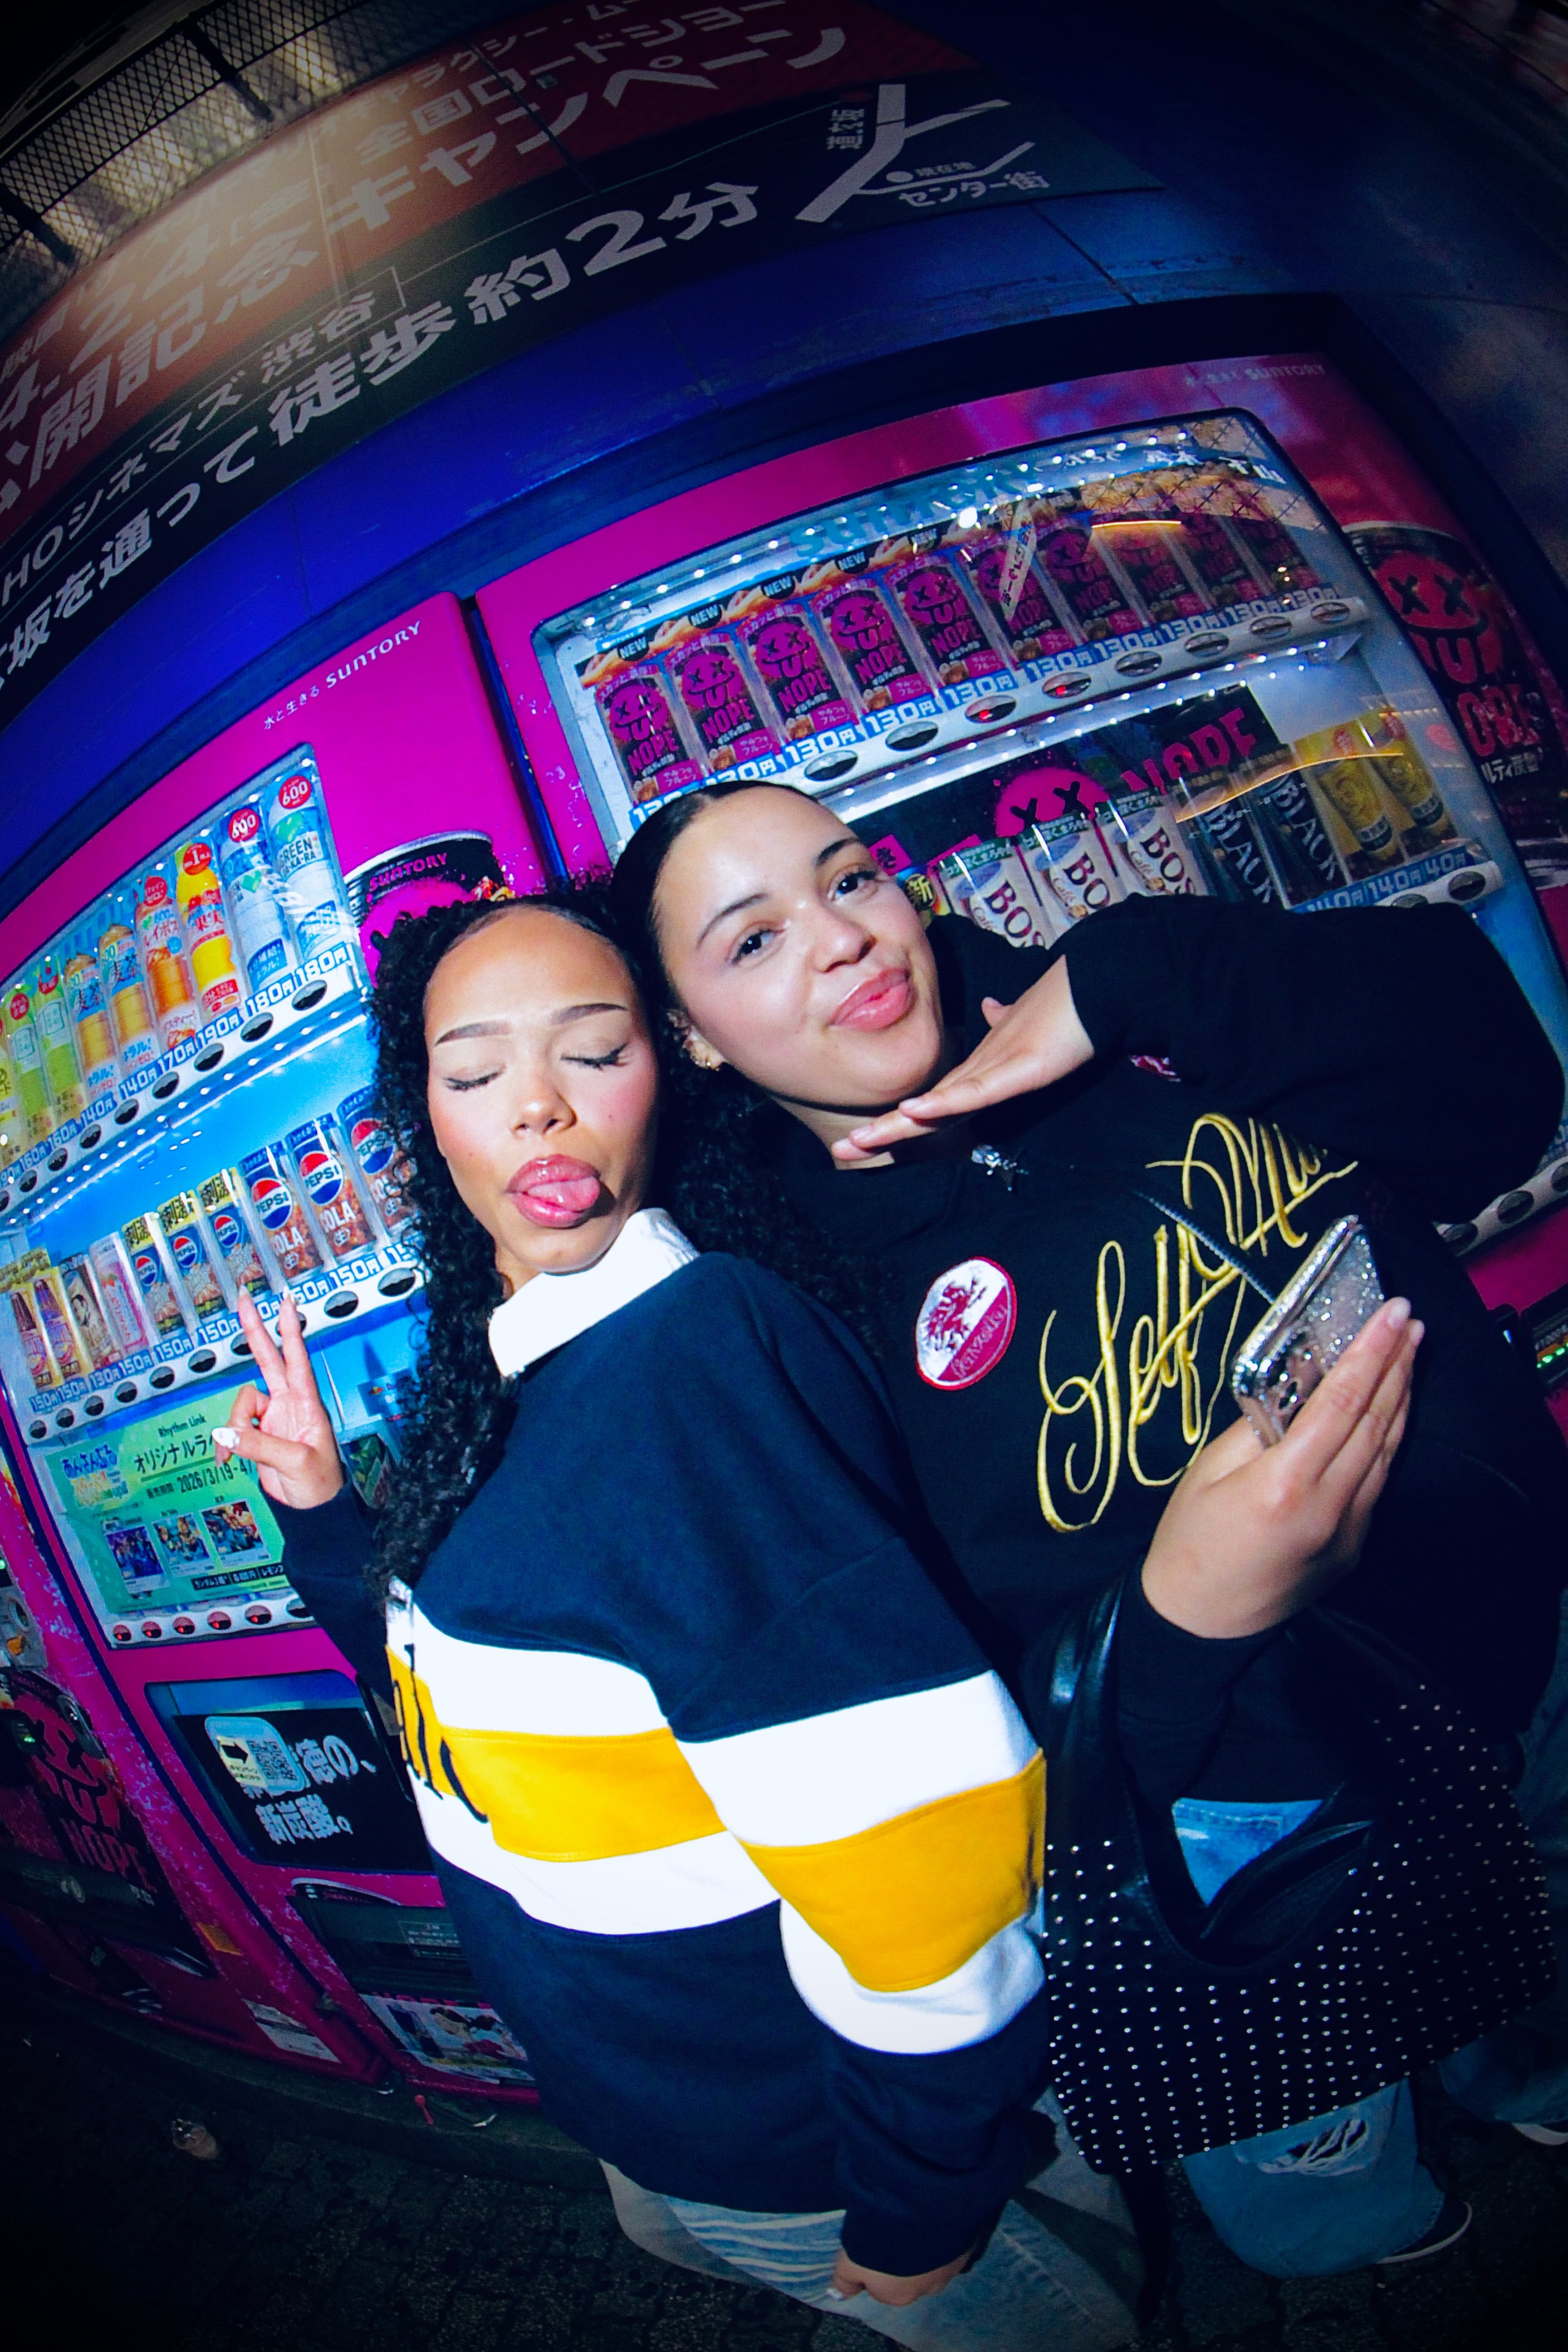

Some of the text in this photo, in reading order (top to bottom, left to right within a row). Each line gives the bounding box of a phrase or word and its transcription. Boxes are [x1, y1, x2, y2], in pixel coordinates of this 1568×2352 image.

[897, 169, 1051, 207] センター街
[262, 290, 375, 383] 渋谷
[0, 183, 758, 692] 坂を通って徒歩約2分
[838, 551, 865, 570] NEW
[764, 576, 792, 596] NEW
[691, 606, 719, 627] NEW
[620, 637, 647, 659] NEW
[1095, 631, 1158, 657] 130円
[263, 620, 421, 729] 水と生きる SUNTORY
[855, 642, 907, 683] NOPE
[1028, 650, 1091, 679] 130円
[778, 668, 832, 712] NOPE
[945, 674, 1014, 705] 130円
[702, 699, 755, 743] NOPE
[867, 700, 936, 738] 130円
[628, 729, 679, 775] NOPE
[785, 728, 856, 764] 130円
[283, 780, 308, 805] 600
[232, 814, 256, 839] 600
[1023, 818, 1087, 848] コ深くまろやか
[1274, 780, 1337, 881] BLACK
[946, 844, 1011, 875] コ深くまろやか
[1205, 804, 1273, 904] BLACK
[368, 853, 447, 892] SUNTORY
[1369, 870, 1421, 900] 140円
[296, 947, 347, 984] 180円
[246, 980, 293, 1017] 180円
[198, 1014, 239, 1044] 190円
[159, 1039, 195, 1070] 170円
[120, 1066, 157, 1096] 140円
[81, 1098, 113, 1127] 140円
[48, 1122, 76, 1149] 160円
[331, 1256, 379, 1284] 150円
[198, 1318, 240, 1344] 150円
[119, 1355, 152, 1374] 150円
[156, 1338, 192, 1363] 150円
[57, 1382, 86, 1400] 150円
[91, 1368, 120, 1388] 130円
[157, 1412, 207, 1438] Rhythm Link
[255, 1793, 353, 1845] 新炭酸。
